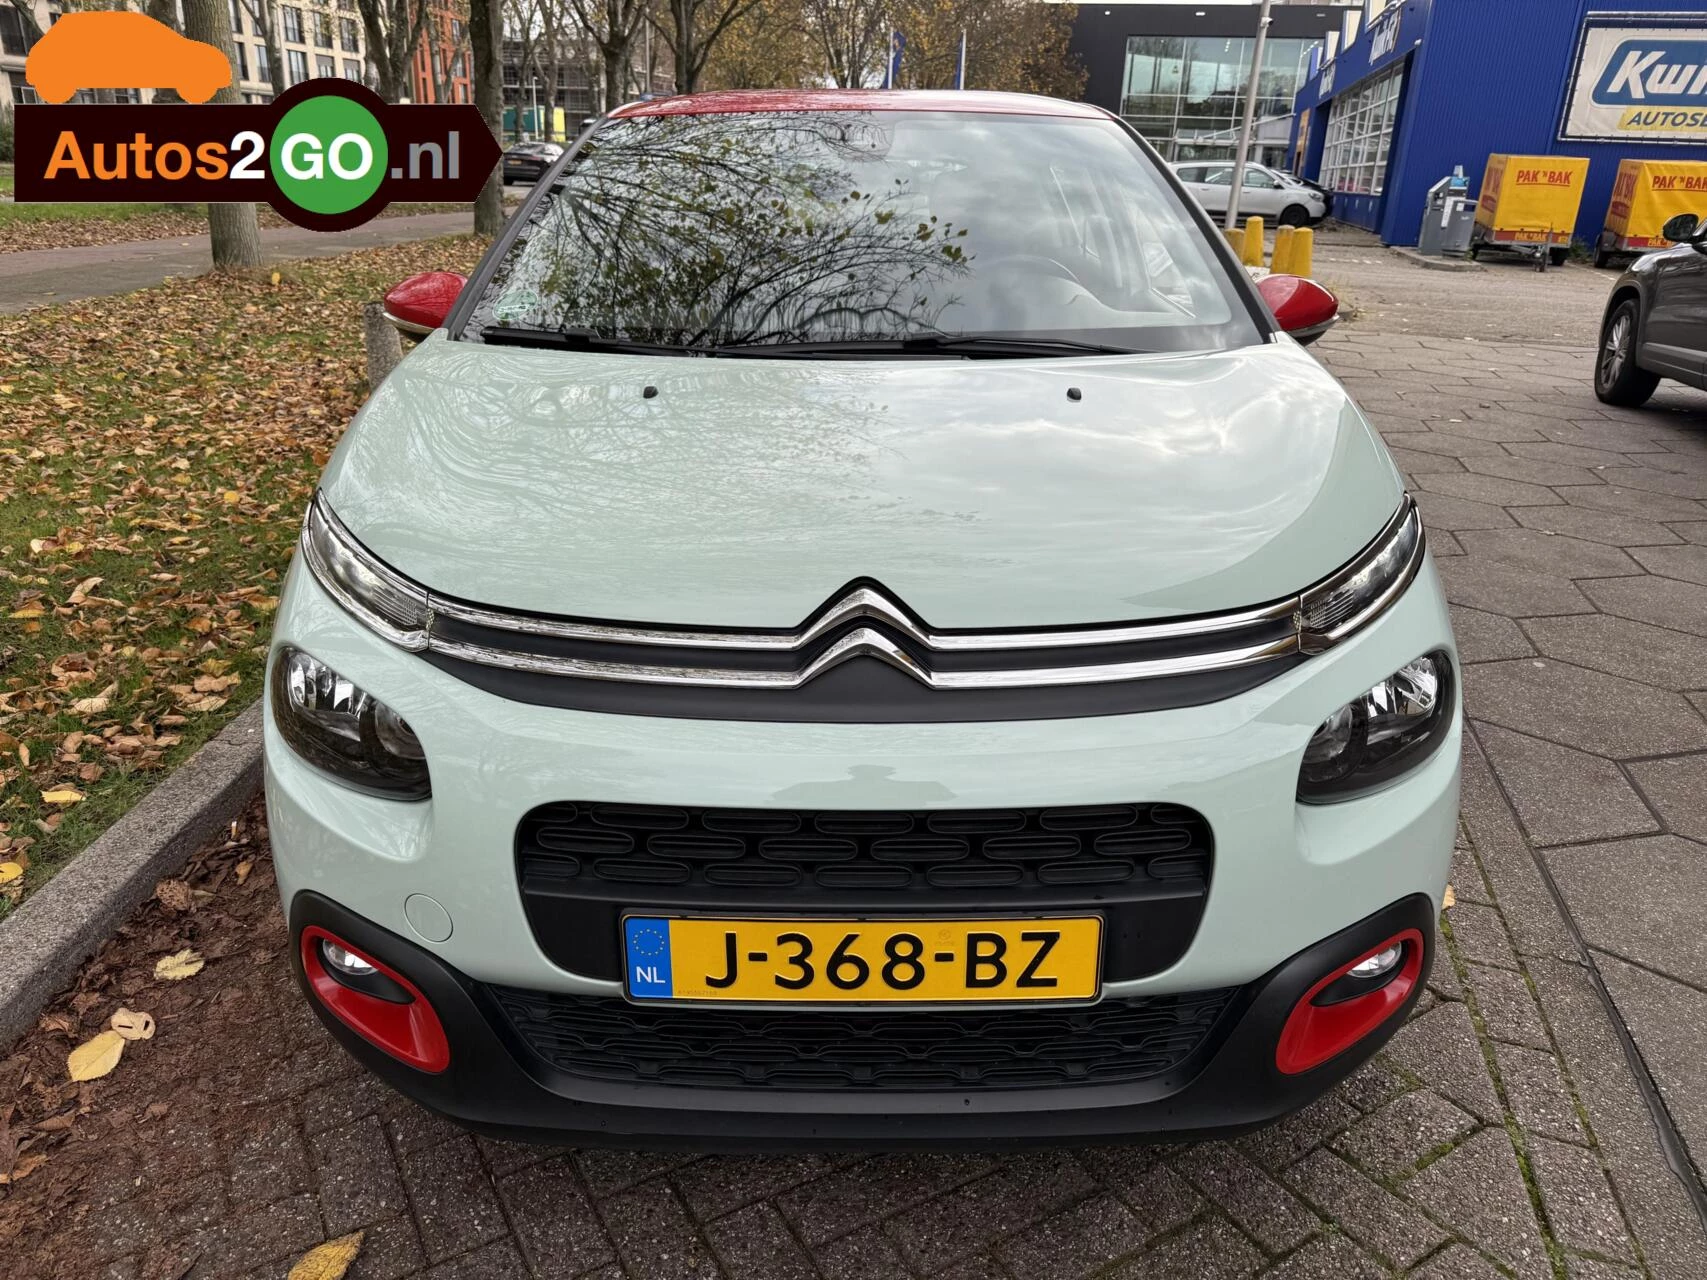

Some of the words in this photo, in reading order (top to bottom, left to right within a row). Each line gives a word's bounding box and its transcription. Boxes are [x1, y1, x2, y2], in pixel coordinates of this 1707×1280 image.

[1607, 50, 1707, 98] Kwi
[1516, 170, 1541, 183] PAK
[1548, 171, 1573, 185] BAK
[1652, 175, 1677, 188] PAK
[705, 930, 1061, 991] J-368-BZ
[636, 966, 666, 983] NL
